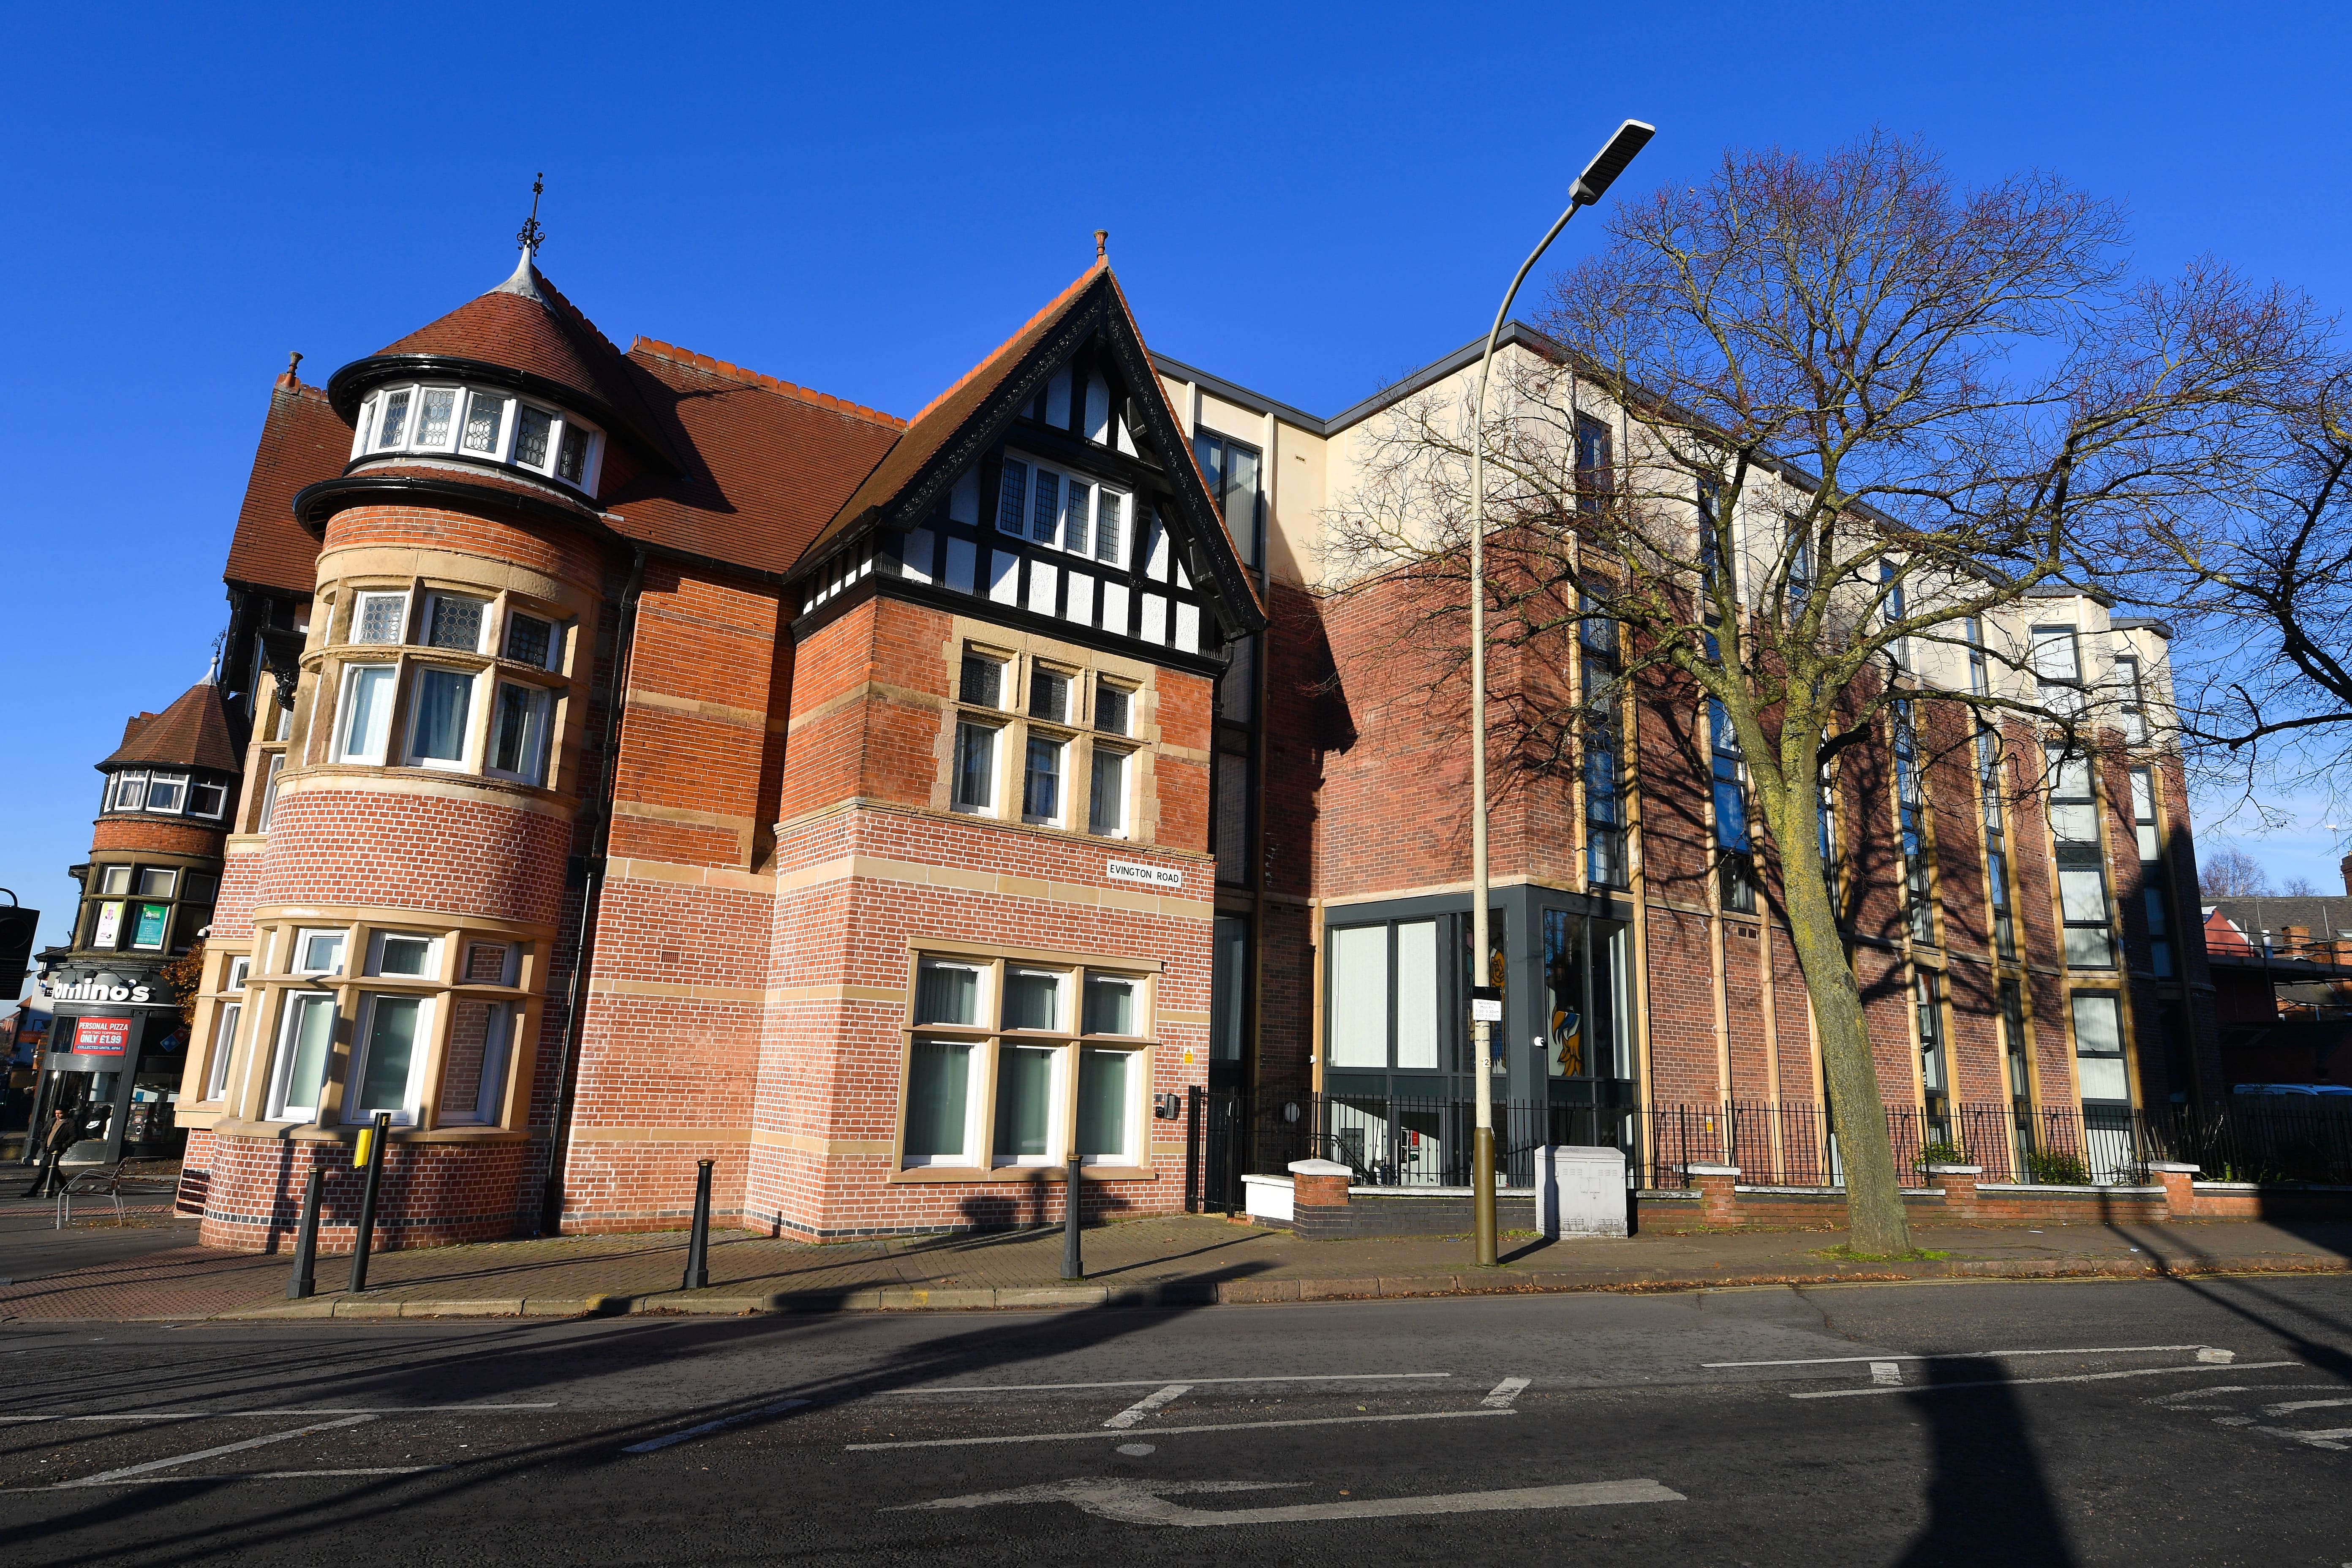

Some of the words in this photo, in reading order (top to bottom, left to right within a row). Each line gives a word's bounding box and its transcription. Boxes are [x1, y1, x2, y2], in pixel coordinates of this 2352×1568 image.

[1110, 864, 1152, 879] EVINGTON
[1157, 872, 1179, 883] ROAD
[80, 1034, 99, 1043] ONLY
[99, 1034, 122, 1044] £1.99
[384, 1117, 389, 1125] 2
